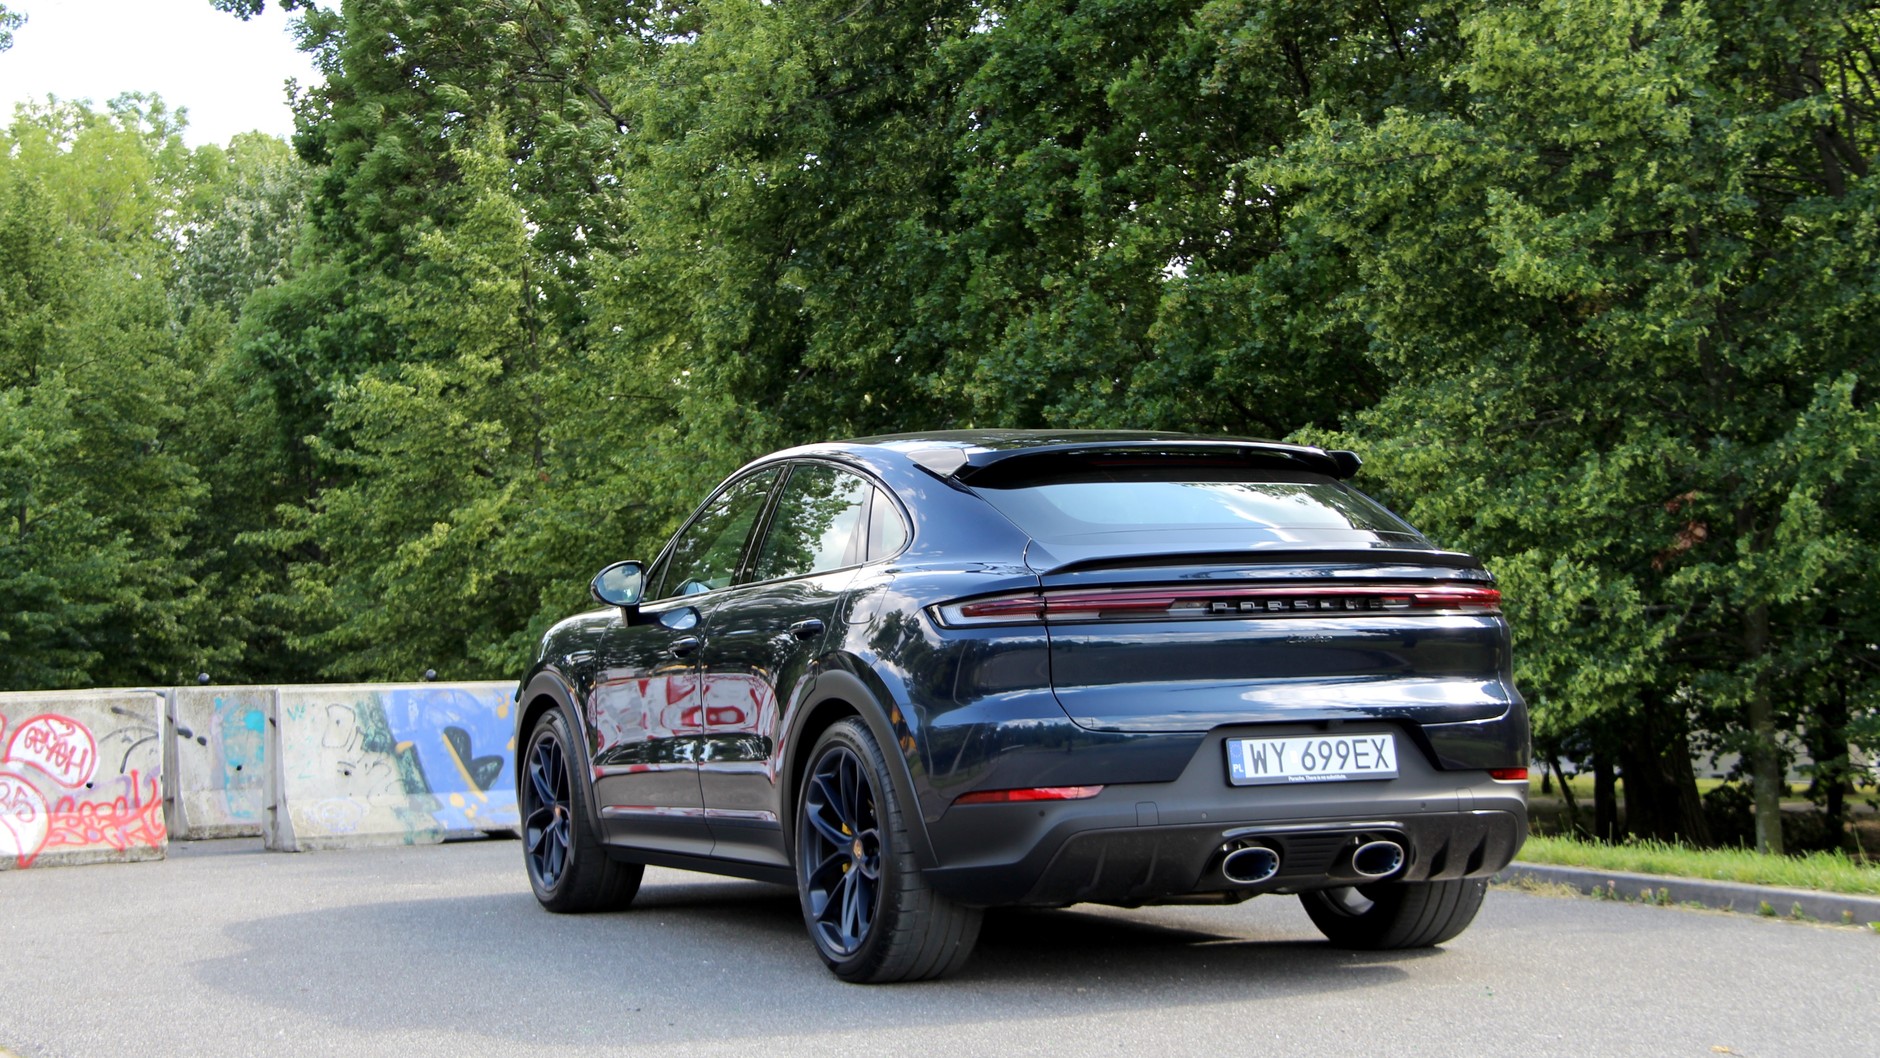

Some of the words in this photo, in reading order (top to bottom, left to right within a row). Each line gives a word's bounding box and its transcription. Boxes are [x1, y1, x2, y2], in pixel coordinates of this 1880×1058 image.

[1233, 763, 1245, 773] PL
[1250, 742, 1286, 775] WY
[1301, 738, 1390, 772] 699EX
